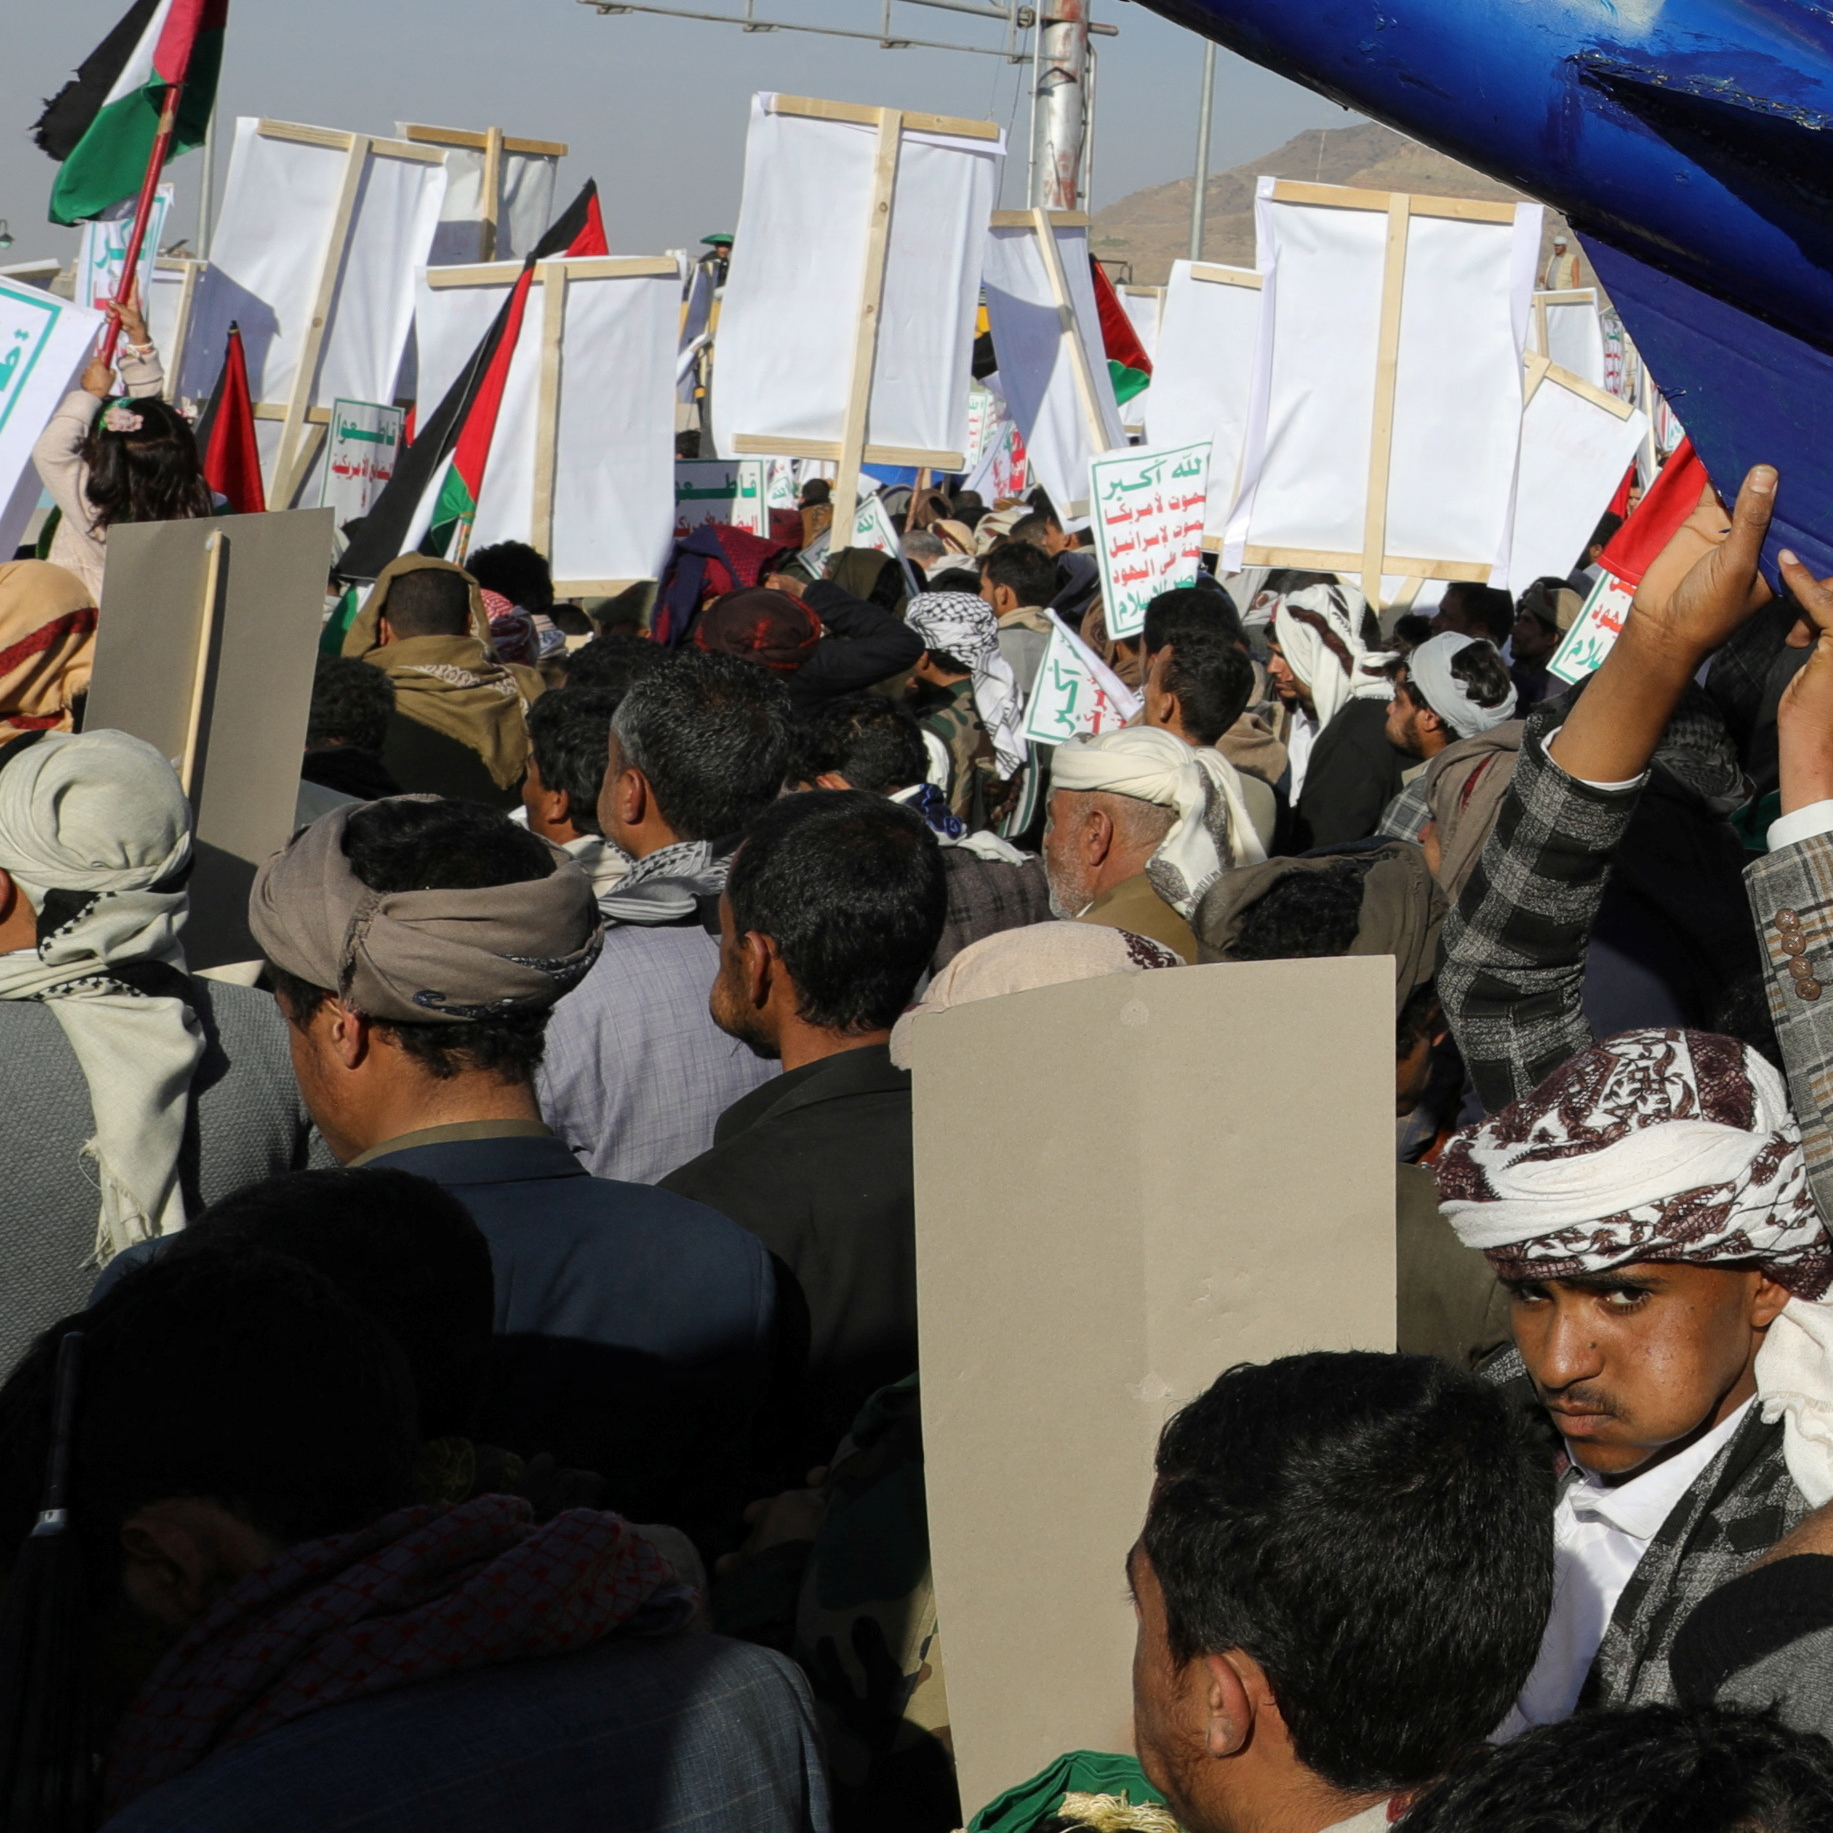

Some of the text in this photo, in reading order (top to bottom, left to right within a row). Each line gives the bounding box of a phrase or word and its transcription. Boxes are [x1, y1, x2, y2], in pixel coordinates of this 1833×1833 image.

[1102, 458, 1168, 501] أكبر
[1104, 490, 1206, 526] موت لأمريكا
[1110, 519, 1204, 559] موت لإسرائيل
[1113, 557, 1155, 587] اليهود
